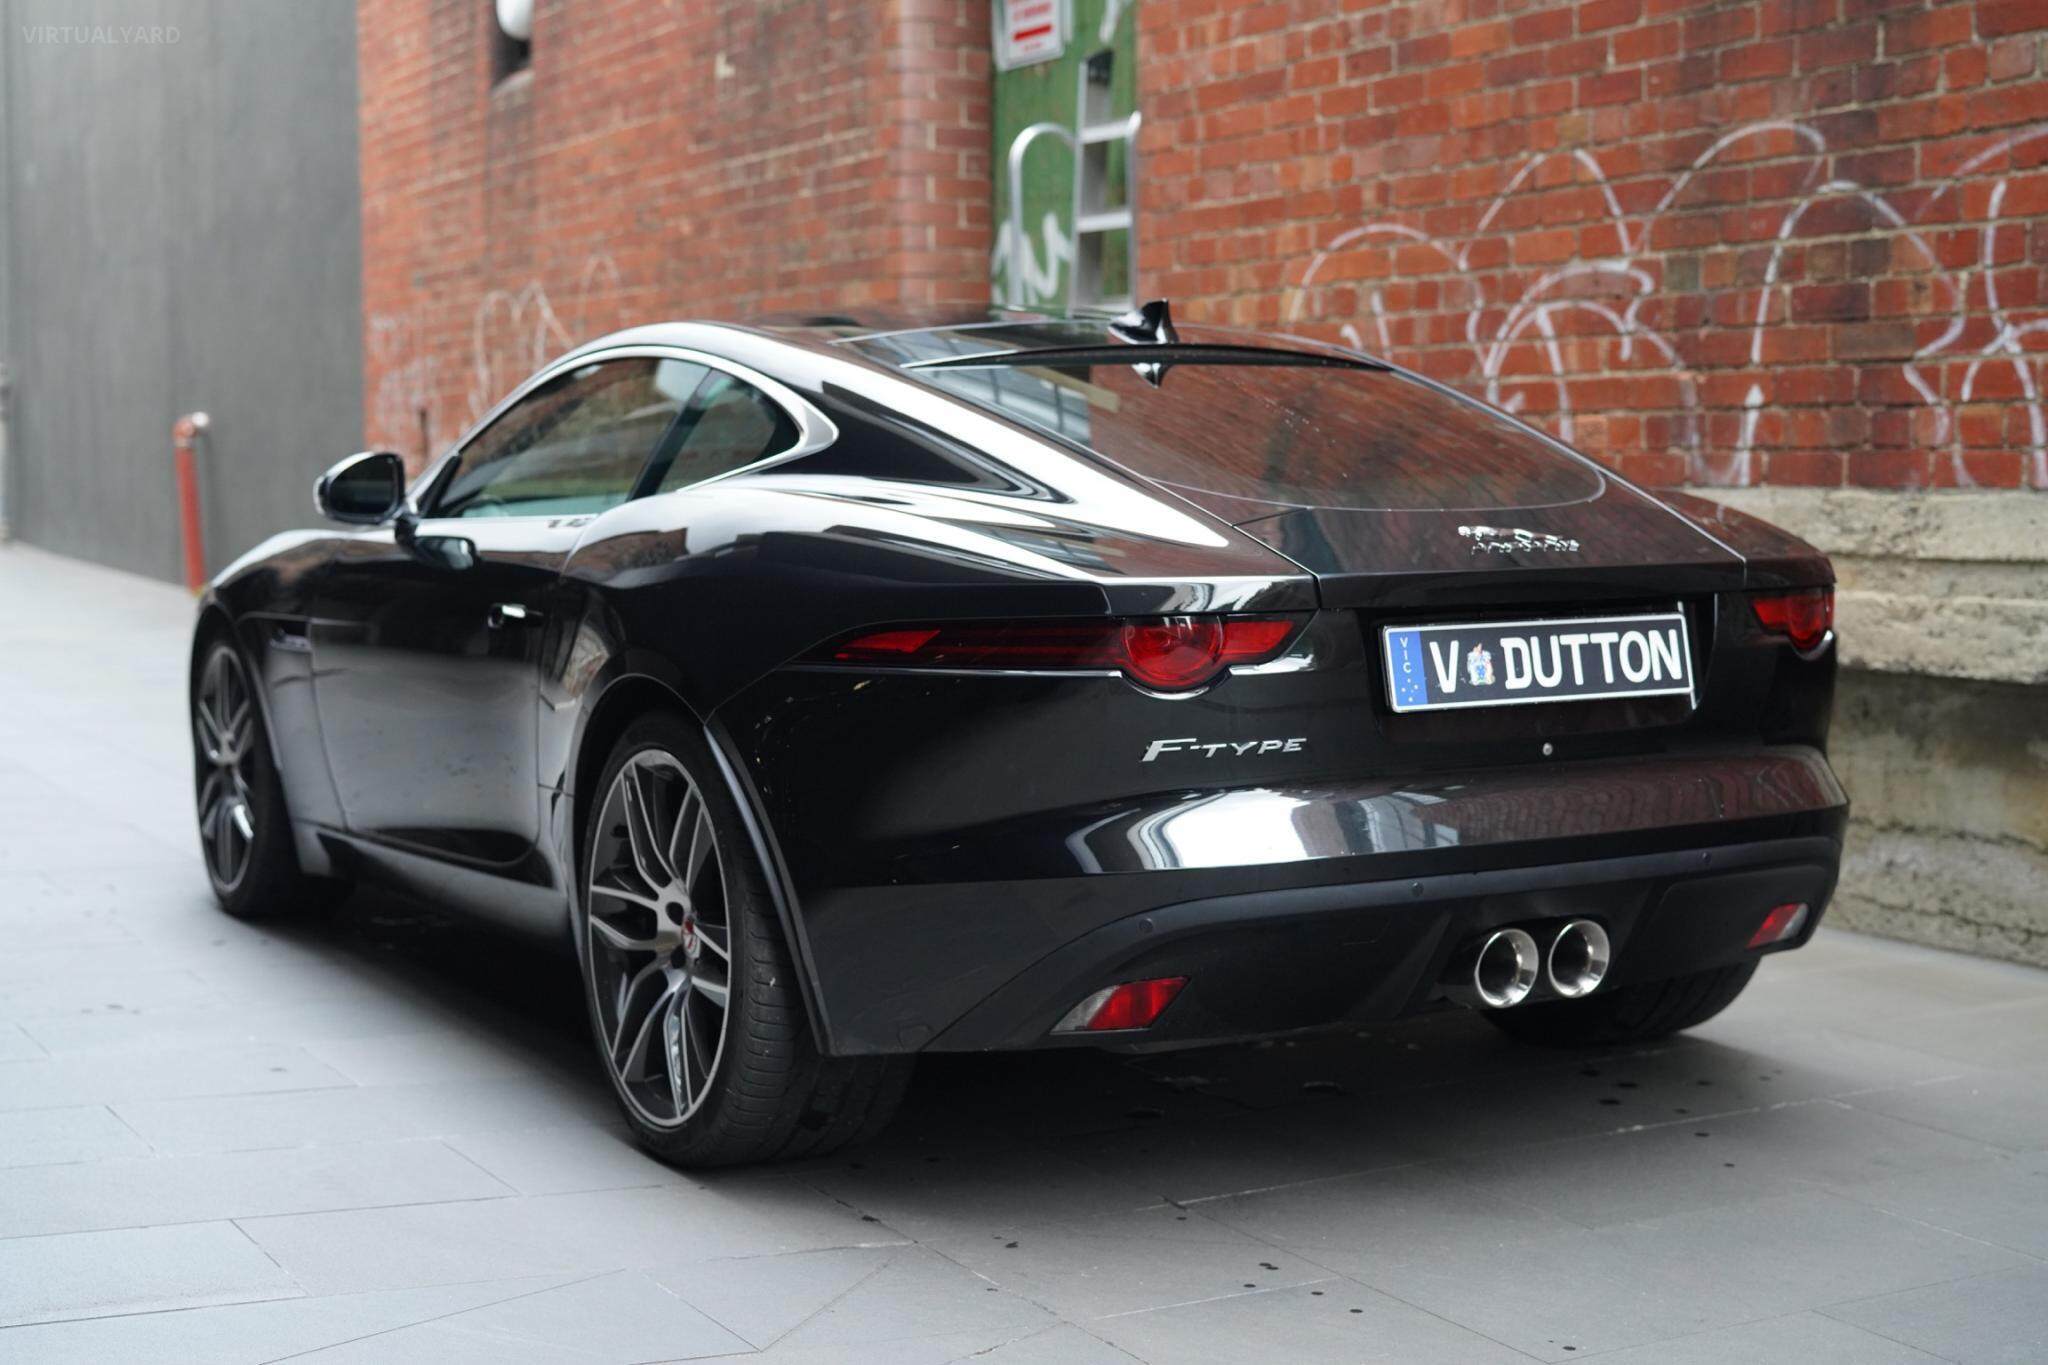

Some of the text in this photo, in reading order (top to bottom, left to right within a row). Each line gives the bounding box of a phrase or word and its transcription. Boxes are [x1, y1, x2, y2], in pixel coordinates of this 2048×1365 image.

[1400, 637, 1412, 673] VIC
[1429, 629, 1682, 693] V DUTTON
[1141, 738, 1307, 762] F-TYPE
